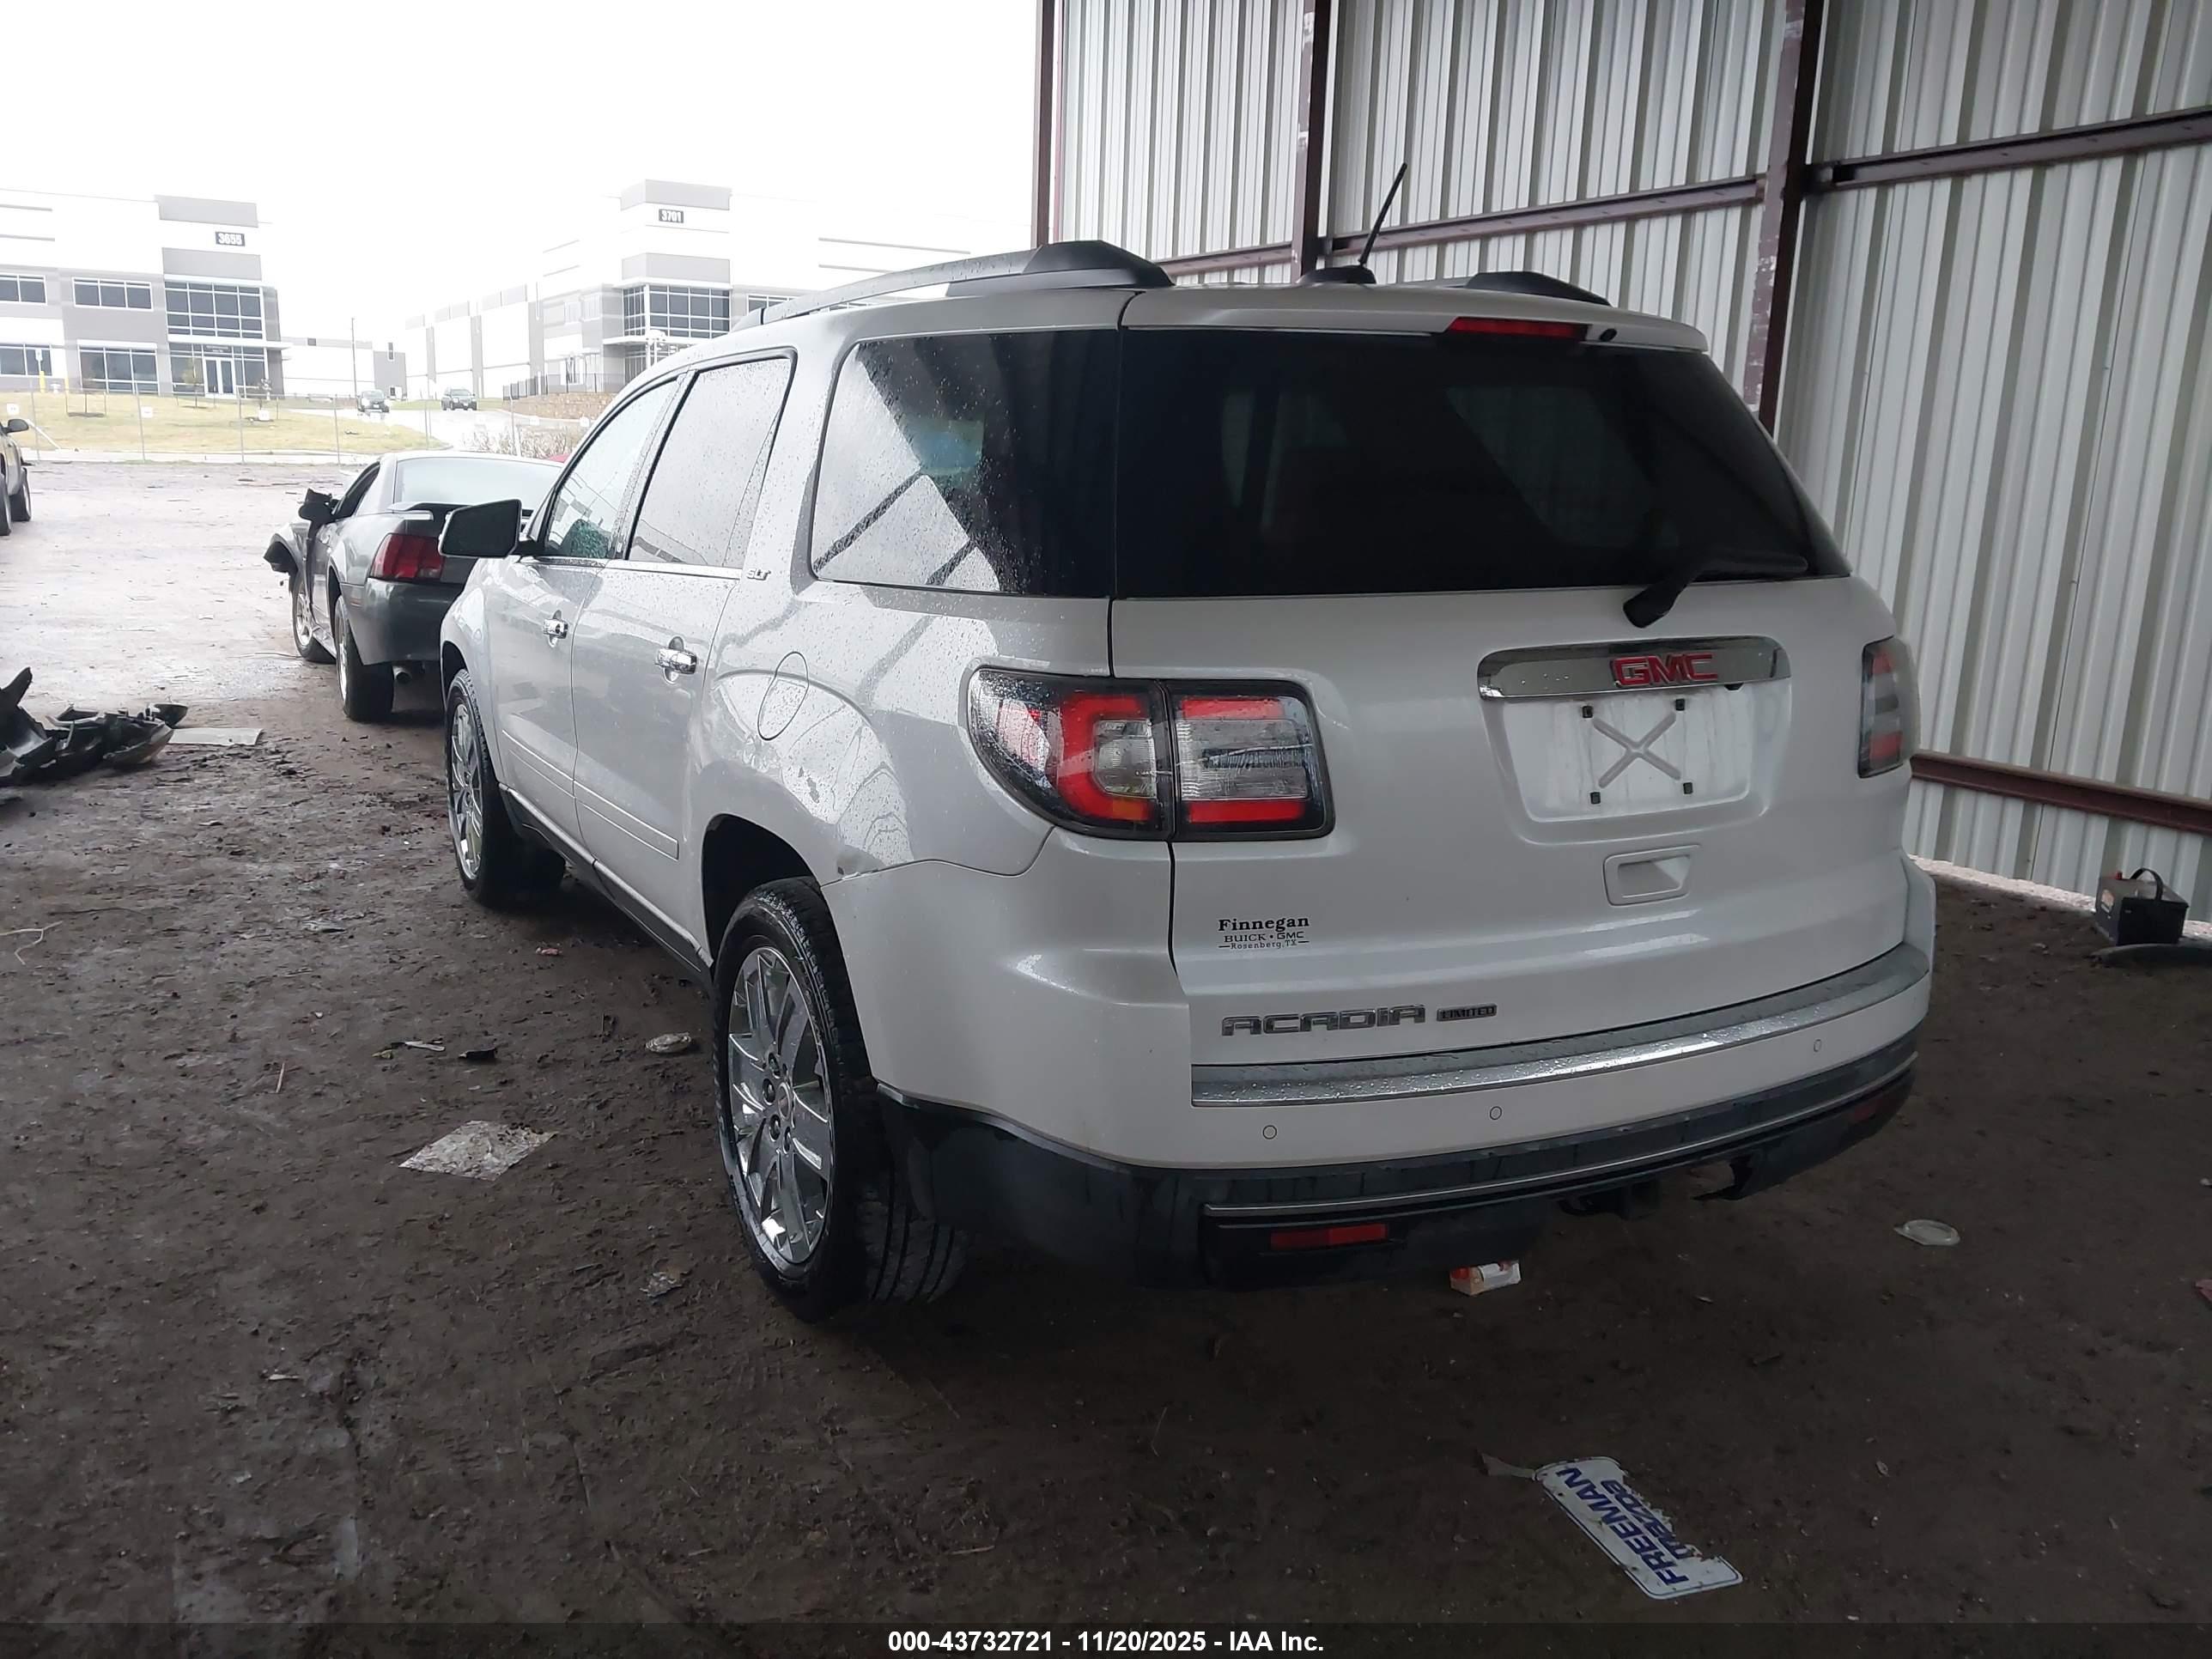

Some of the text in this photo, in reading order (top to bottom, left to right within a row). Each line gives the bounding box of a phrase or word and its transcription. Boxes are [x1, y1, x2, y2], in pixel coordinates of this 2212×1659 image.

[660, 210, 682, 222] 3701
[1610, 652, 1718, 688] GMC
[1218, 917, 1310, 932] Finnegan
[1224, 931, 1304, 943] BUICK GMC
[1221, 1004, 1496, 1036] ACADIA LIMITED
[1555, 1467, 1690, 1586] FREEMAN
